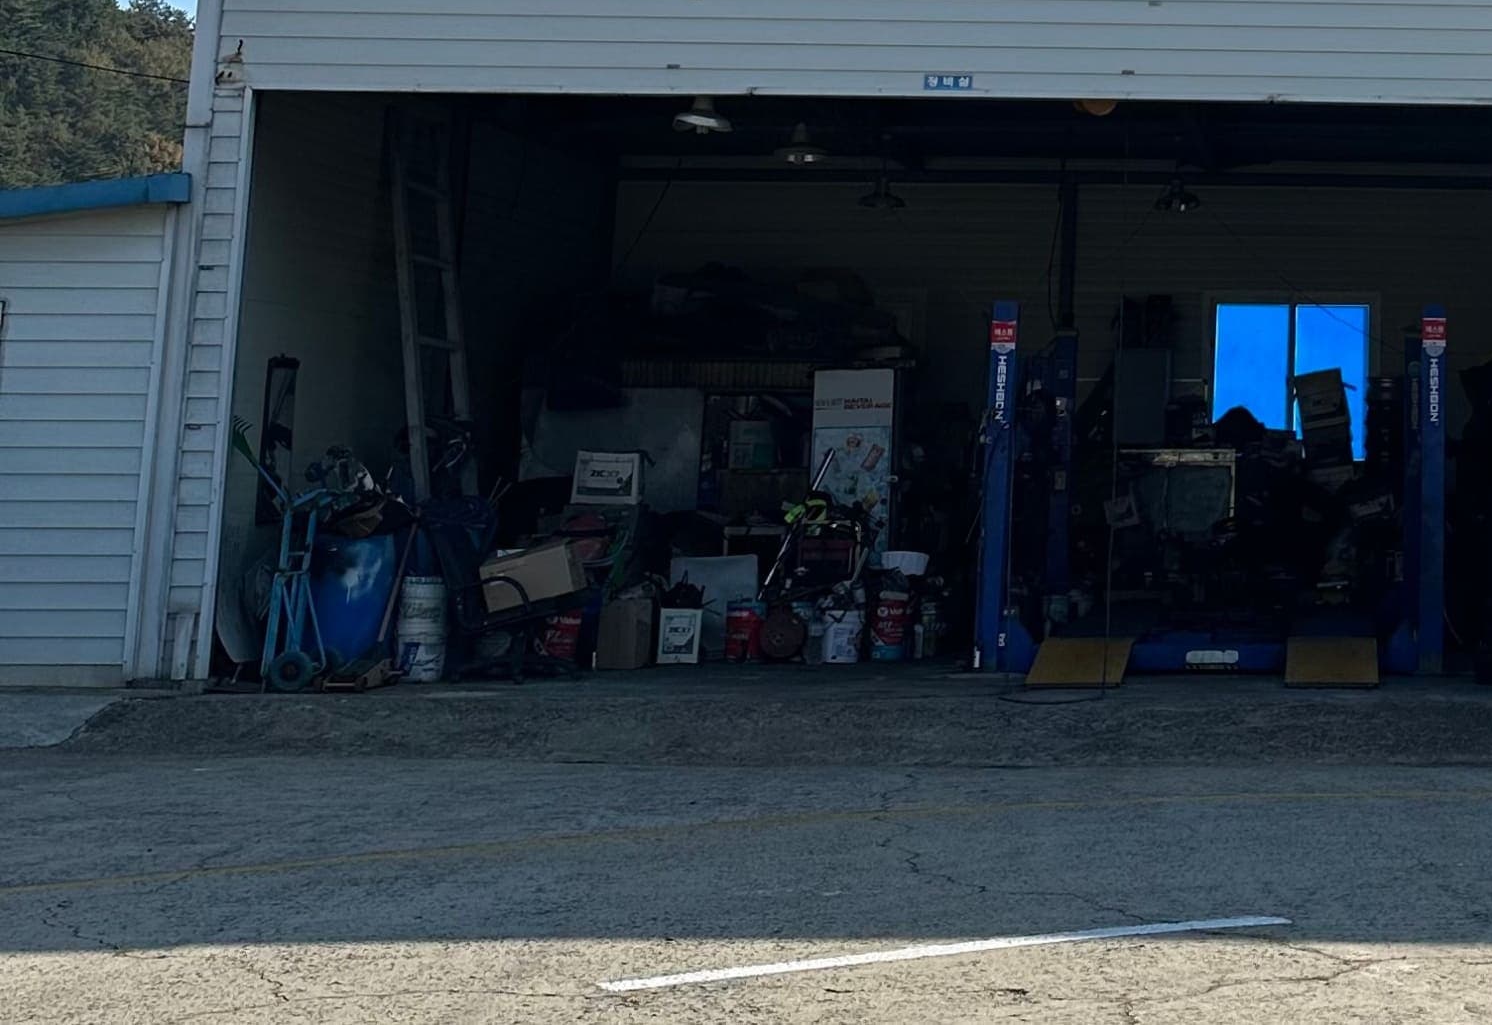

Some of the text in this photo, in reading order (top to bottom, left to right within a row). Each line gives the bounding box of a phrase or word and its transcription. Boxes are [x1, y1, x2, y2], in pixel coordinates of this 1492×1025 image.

[927, 76, 969, 88] 정비실
[994, 355, 1008, 421] HESHBON
[1429, 357, 1440, 423] HESHBON
